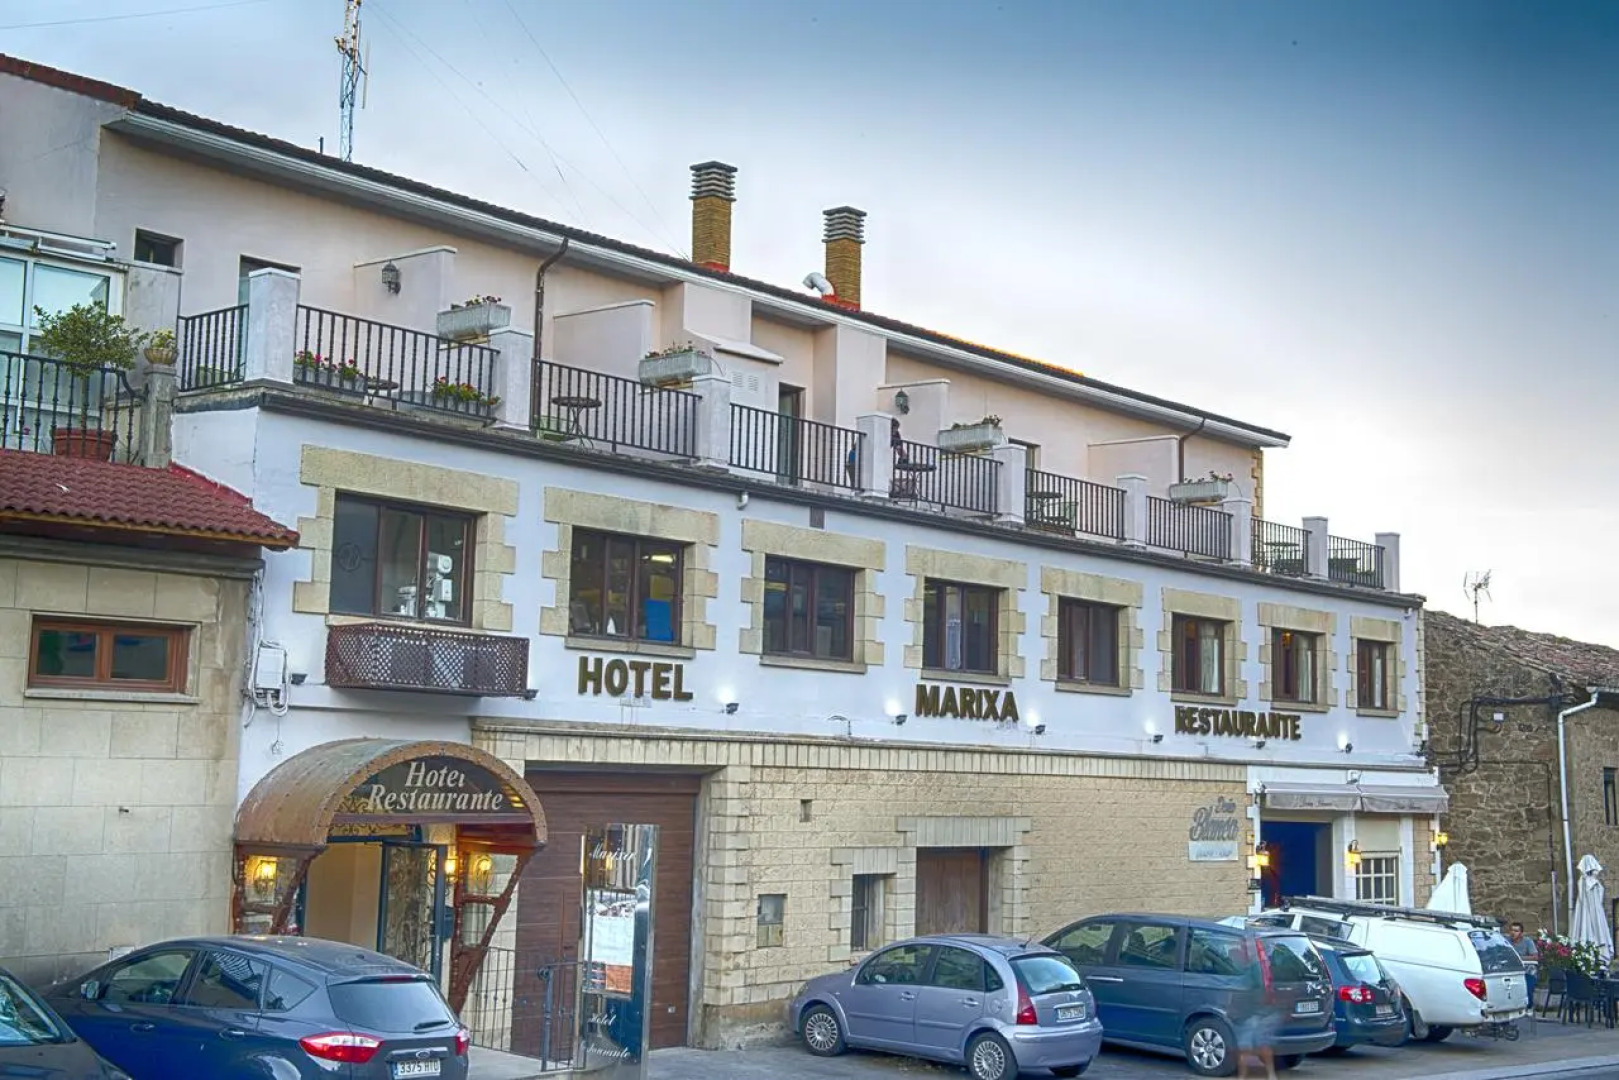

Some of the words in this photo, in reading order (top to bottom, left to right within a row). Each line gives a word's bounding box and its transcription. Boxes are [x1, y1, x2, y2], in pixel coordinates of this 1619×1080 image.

[578, 656, 693, 701] HOTEL
[915, 684, 1019, 722] MARIXA
[1175, 705, 1301, 740] RESTAURANTE
[367, 784, 503, 811] Restaurante
